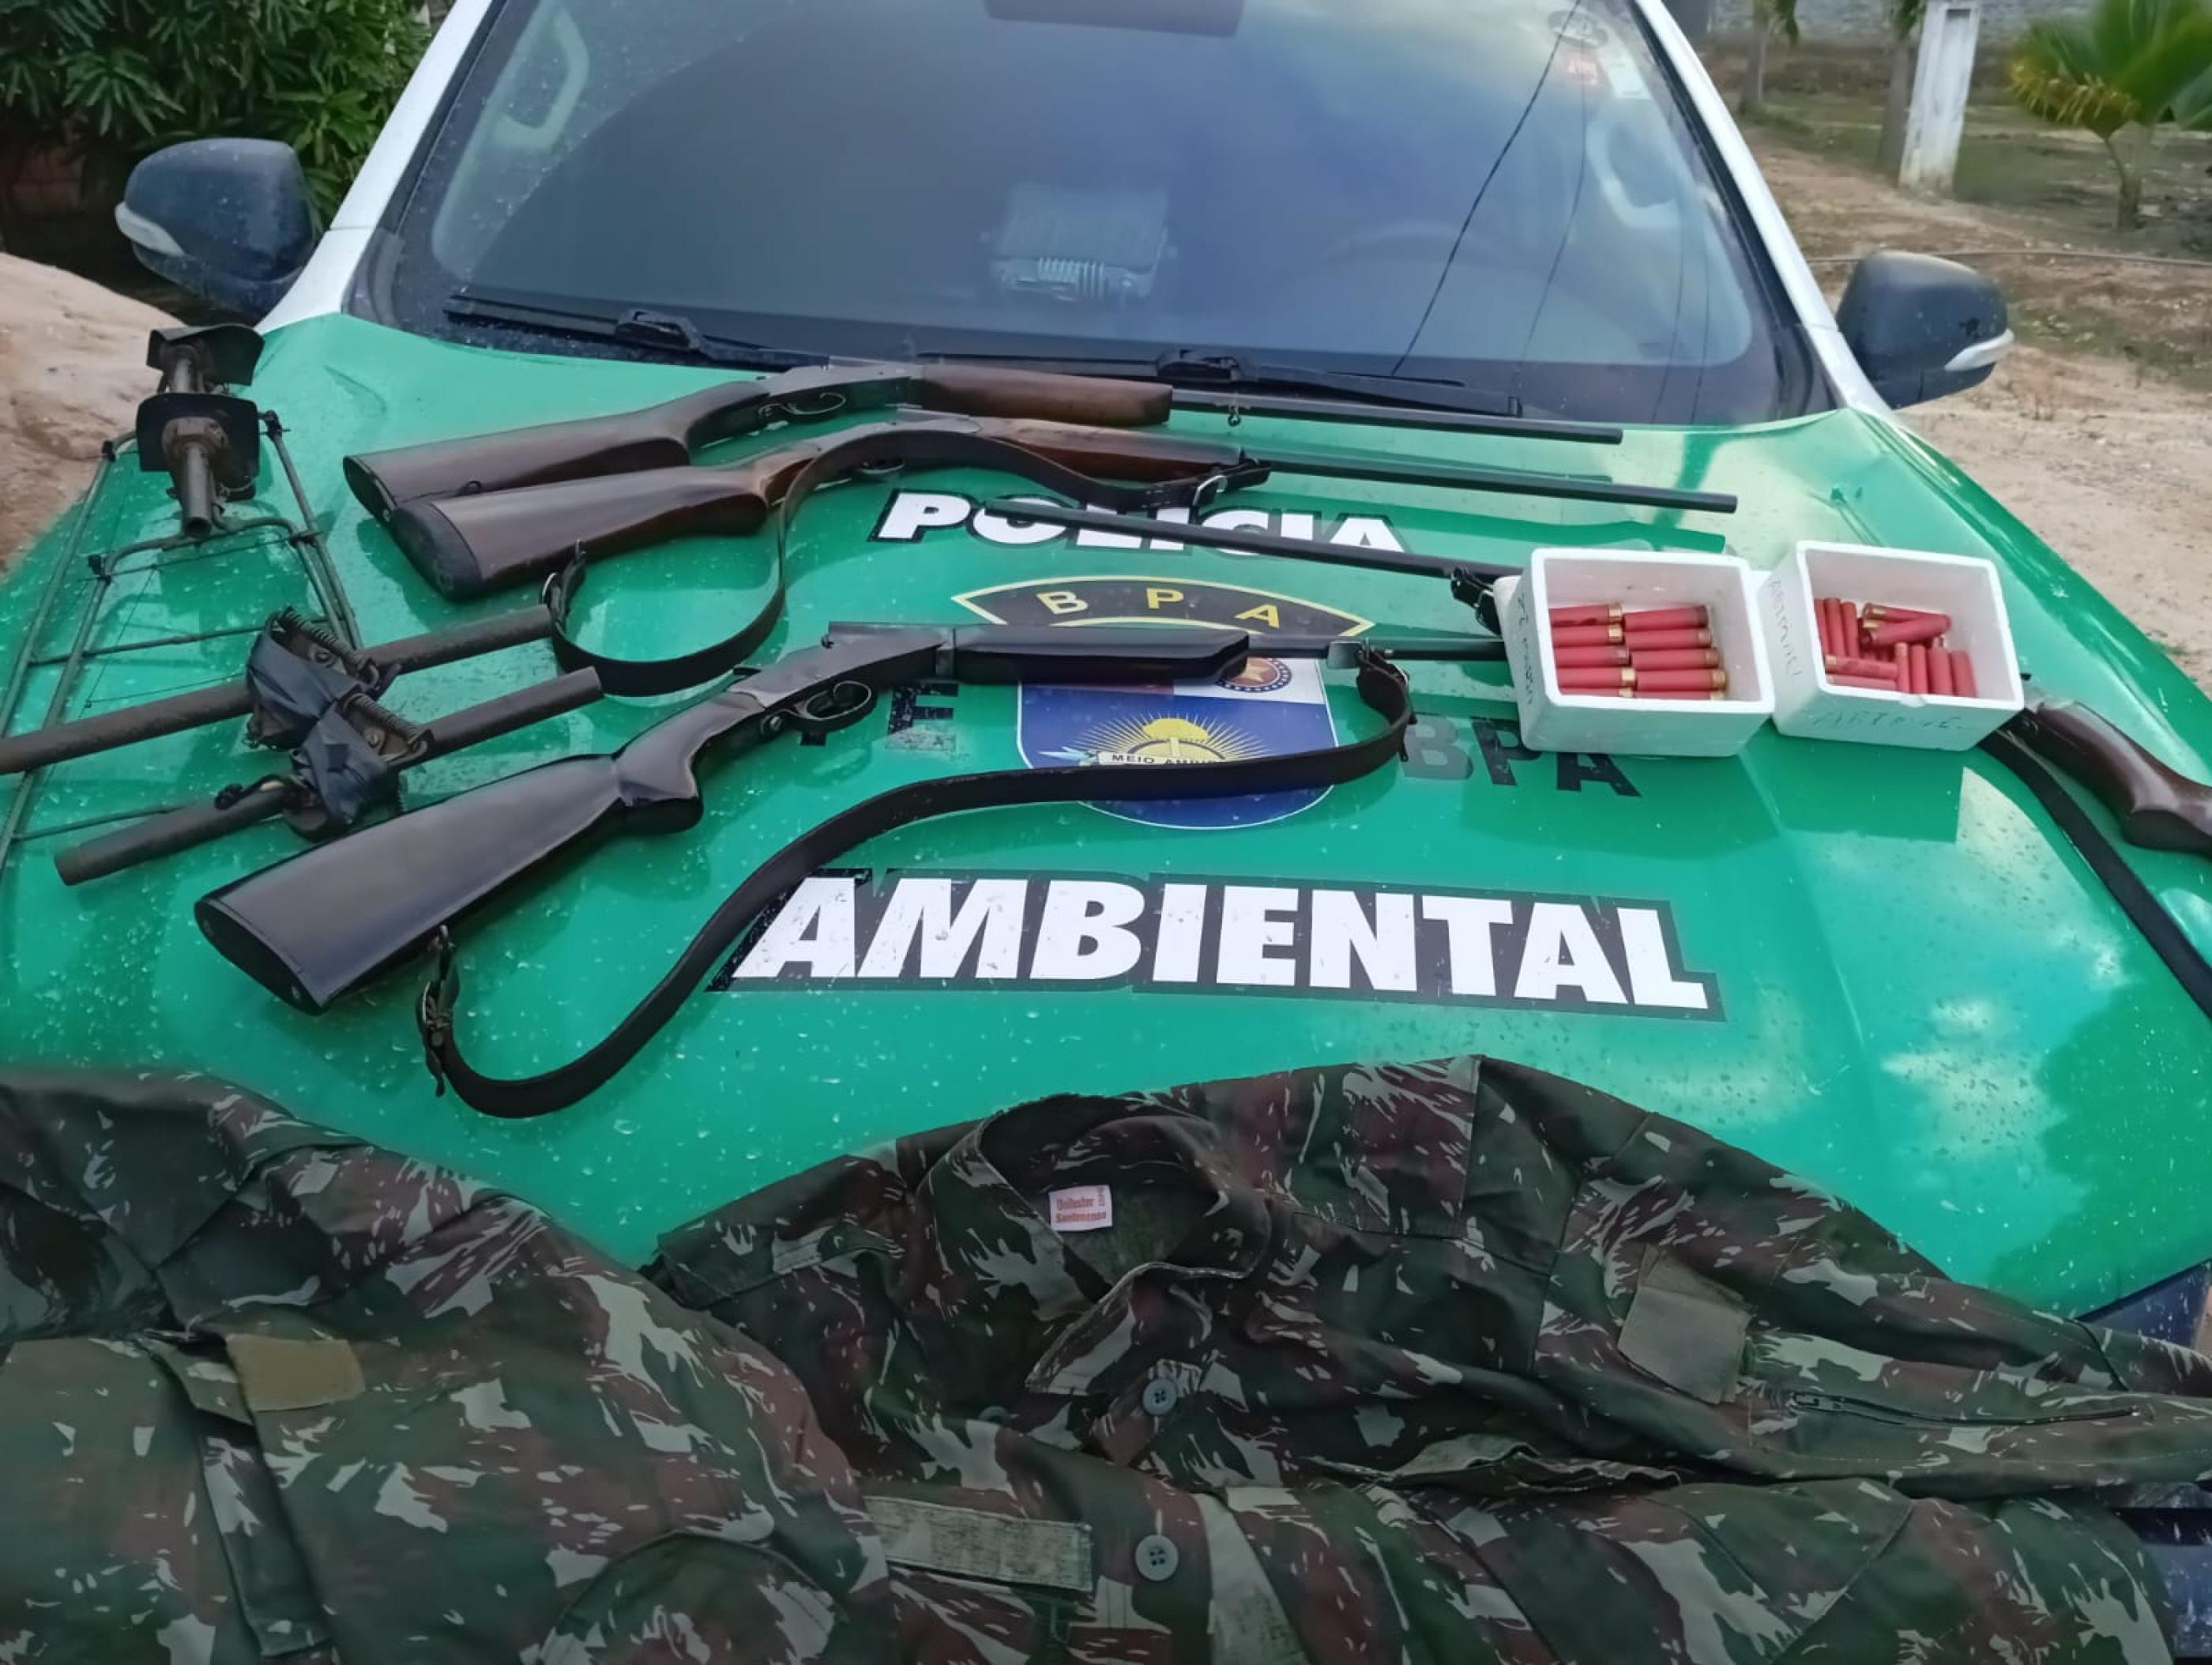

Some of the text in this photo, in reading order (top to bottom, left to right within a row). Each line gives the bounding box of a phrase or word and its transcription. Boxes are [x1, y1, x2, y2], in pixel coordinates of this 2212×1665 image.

[1112, 753, 1154, 764] MEIO
[1401, 714, 1642, 797] BPA
[731, 876, 1709, 1009] AMBIENTAL
